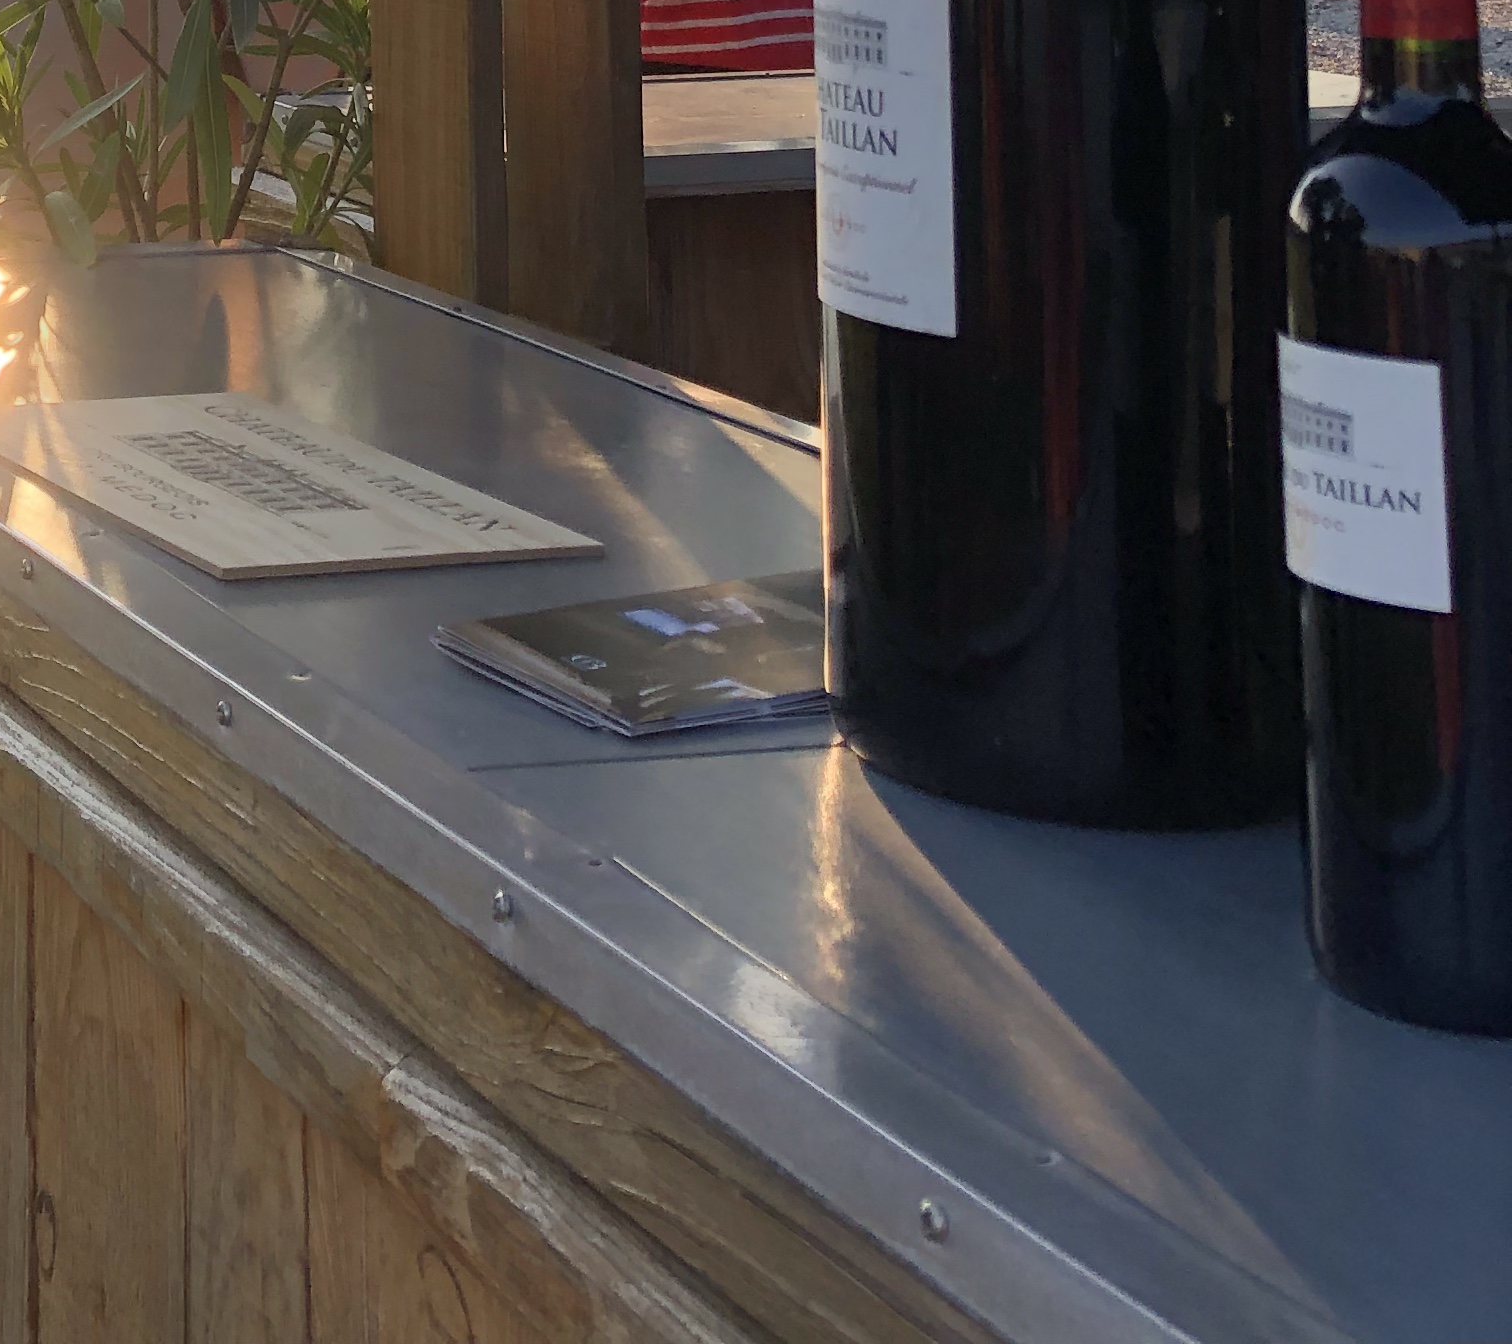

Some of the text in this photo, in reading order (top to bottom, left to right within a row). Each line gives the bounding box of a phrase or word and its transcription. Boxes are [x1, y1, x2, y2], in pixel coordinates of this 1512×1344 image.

[818, 78, 884, 118] HATEAU
[820, 107, 897, 157] TAILLAN
[367, 474, 517, 532] TAILLAN
[1312, 470, 1421, 515] TAILLAN
